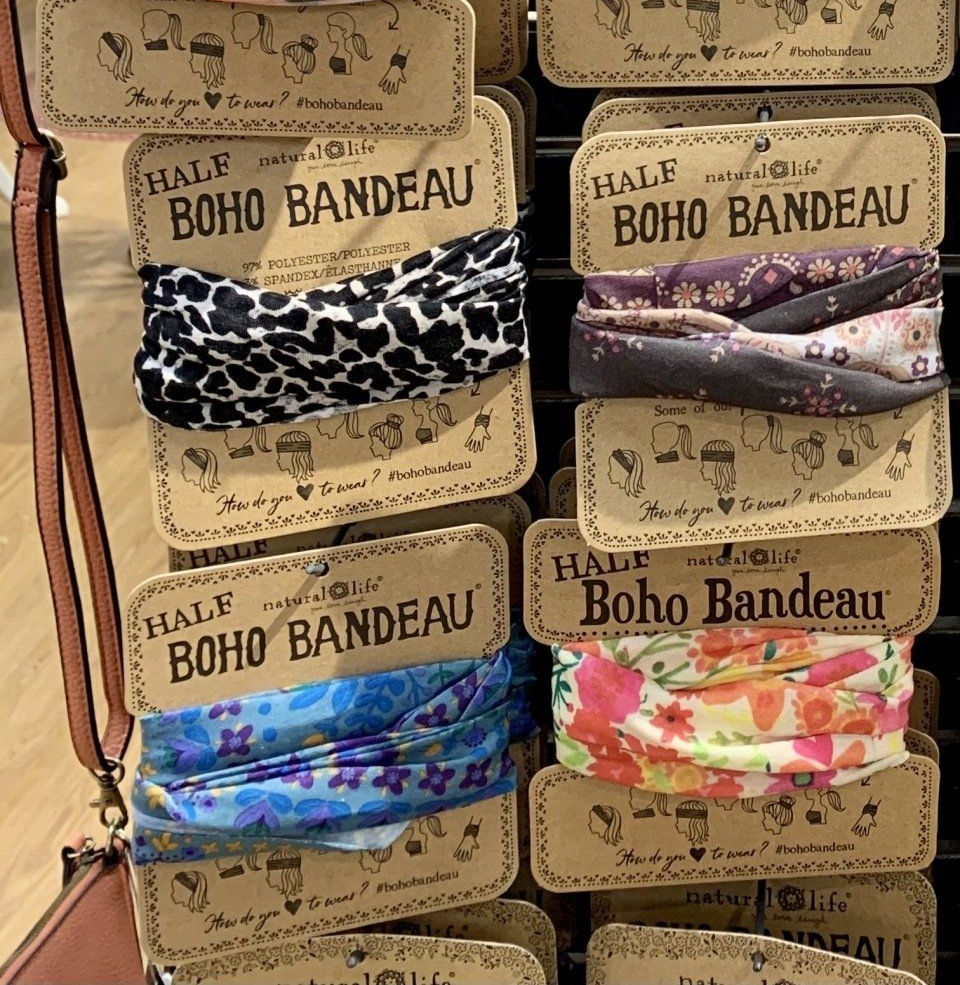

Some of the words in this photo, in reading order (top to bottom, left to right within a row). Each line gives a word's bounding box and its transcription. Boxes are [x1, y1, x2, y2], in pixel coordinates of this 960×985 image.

[624, 42, 656, 63] How
[657, 46, 674, 61] do
[673, 52, 697, 70] you
[722, 47, 736, 60] to
[789, 45, 871, 57] #bohobandeau
[125, 86, 158, 110] How
[160, 93, 175, 108] do
[174, 97, 200, 117] you
[227, 95, 241, 108] to
[297, 96, 383, 112] #bohobandeau
[144, 152, 231, 195] HALF
[259, 145, 322, 167] natural
[705, 166, 768, 184] natural
[591, 159, 678, 199] HALF
[169, 188, 265, 240] BOHO
[613, 198, 706, 247] BOHO
[242, 260, 262, 273] 97%
[268, 242, 411, 270] POLYESTER/POLYESTER
[215, 494, 250, 515] How
[252, 491, 266, 507] do
[266, 494, 293, 514] you
[319, 482, 333, 496] to
[388, 460, 471, 481] #bohobandeau
[639, 500, 672, 522] How
[673, 502, 689, 517] do
[688, 505, 714, 526] you
[739, 497, 754, 511] to
[808, 487, 892, 505] #bohobandeau
[551, 549, 650, 582] HALF
[144, 591, 234, 640] HALF
[263, 588, 328, 612] natural
[580, 577, 688, 627] Boho
[168, 626, 265, 685] BOHO
[616, 848, 648, 867] How
[649, 851, 664, 865] do
[664, 853, 686, 872] you
[712, 847, 725, 860] to
[776, 842, 854, 856] #bohobandeau
[204, 912, 238, 935] How
[241, 909, 255, 925] do
[255, 908, 280, 929] you
[308, 897, 322, 910] to
[376, 871, 459, 894] #bohobandeau
